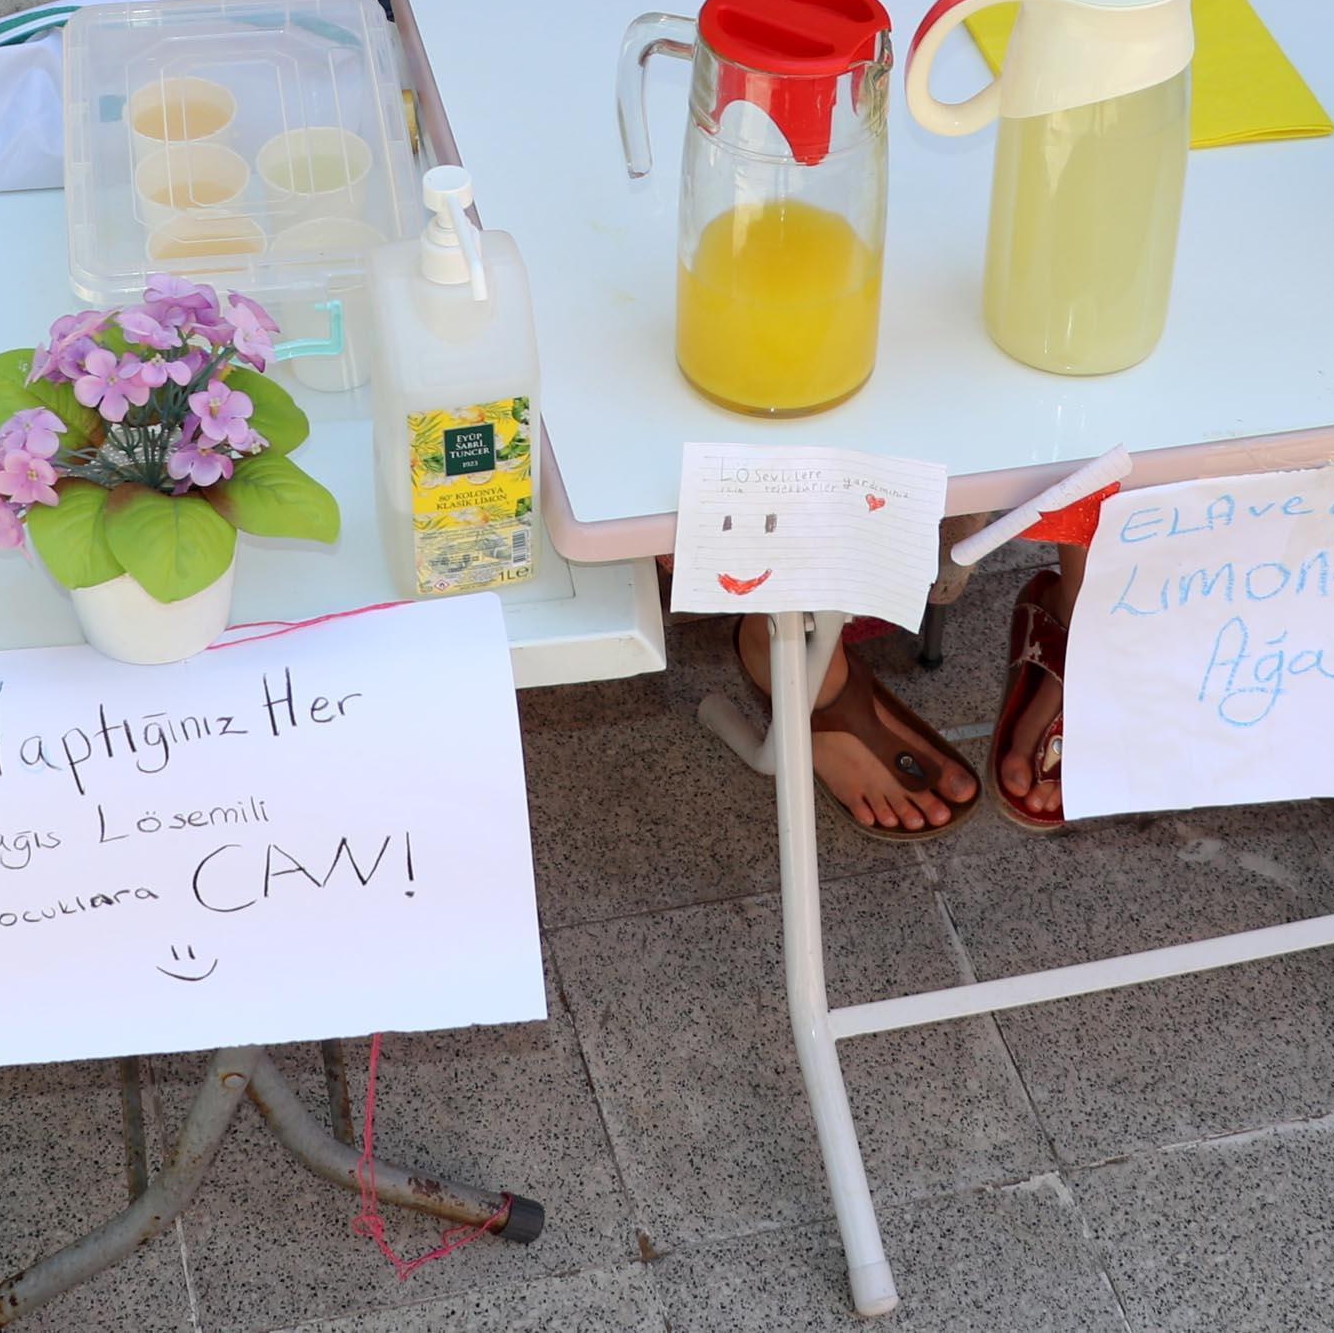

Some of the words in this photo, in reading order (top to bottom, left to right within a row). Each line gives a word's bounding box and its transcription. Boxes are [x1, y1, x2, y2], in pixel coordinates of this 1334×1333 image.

[456, 433, 482, 444] EYÜP
[450, 447, 490, 459] TUNCER
[436, 498, 473, 511] KLASİK
[474, 492, 508, 506] LİMON
[455, 487, 504, 501] KOLONYA
[263, 667, 363, 736] Her
[98, 796, 270, 843] Lösemili
[192, 832, 416, 912] CAN!
